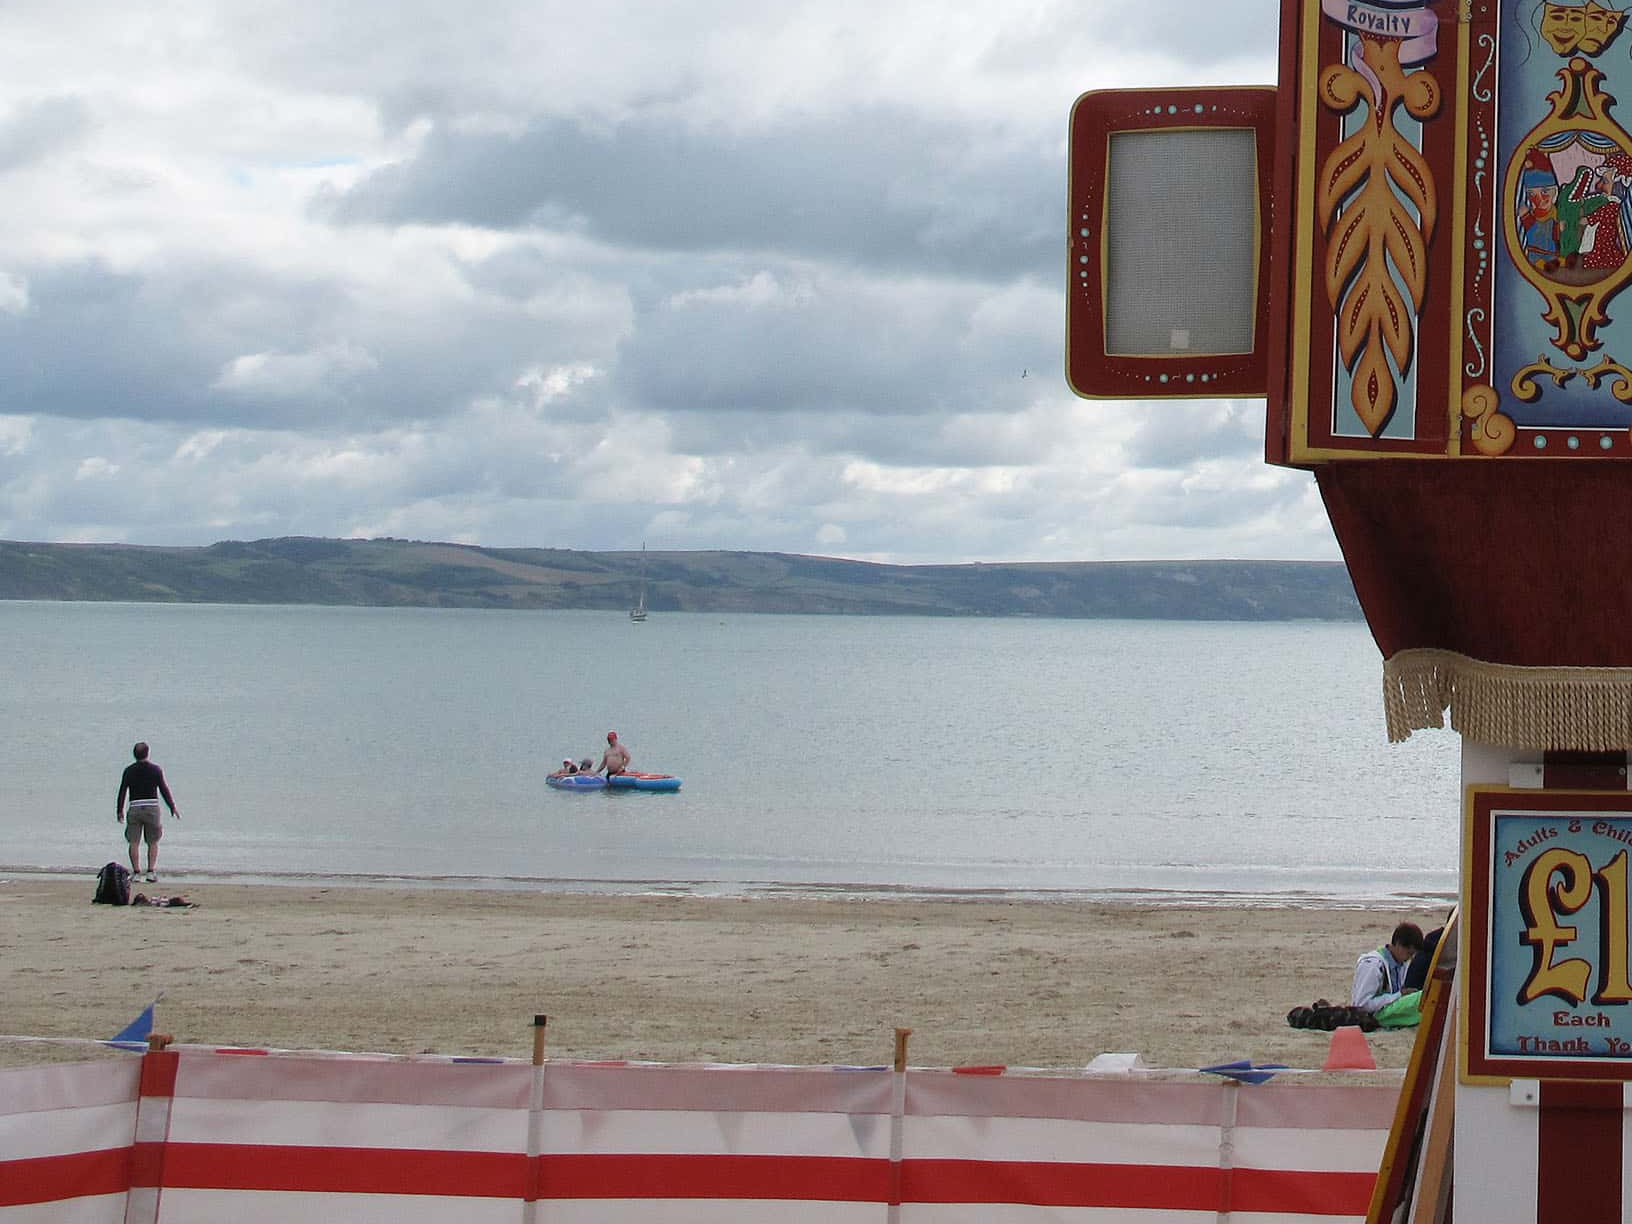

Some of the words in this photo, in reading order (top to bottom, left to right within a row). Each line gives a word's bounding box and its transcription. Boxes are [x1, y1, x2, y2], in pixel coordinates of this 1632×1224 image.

[1347, 5, 1411, 33] Royalty
[1504, 827, 1558, 867] Adults
[1568, 820, 1582, 834] &
[1552, 1011, 1611, 1028] Each
[1517, 1036, 1590, 1053] Thank
